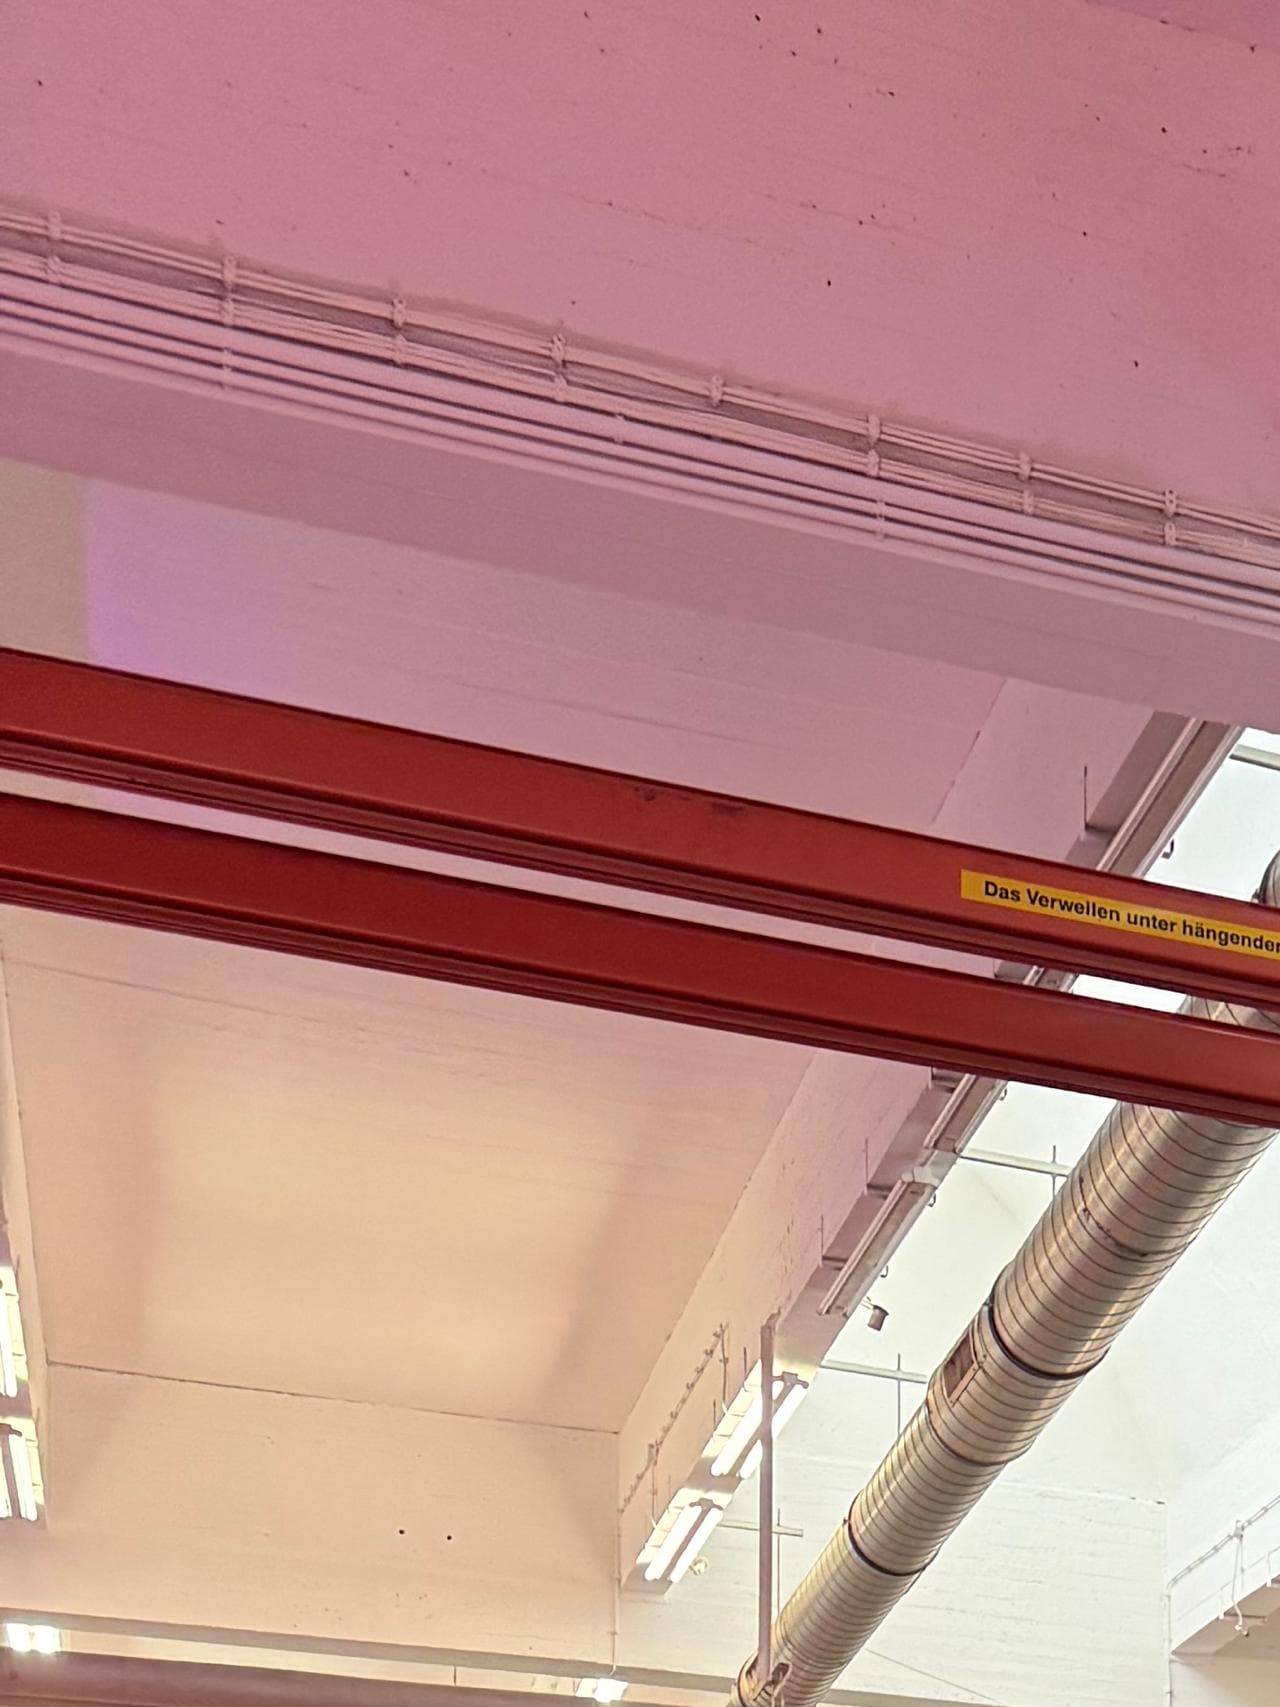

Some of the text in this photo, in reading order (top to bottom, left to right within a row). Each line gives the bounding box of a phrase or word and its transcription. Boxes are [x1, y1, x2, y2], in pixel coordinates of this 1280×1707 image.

[985, 881, 1020, 902] Das
[1027, 888, 1120, 922] Verweilen
[1127, 912, 1177, 932] unter
